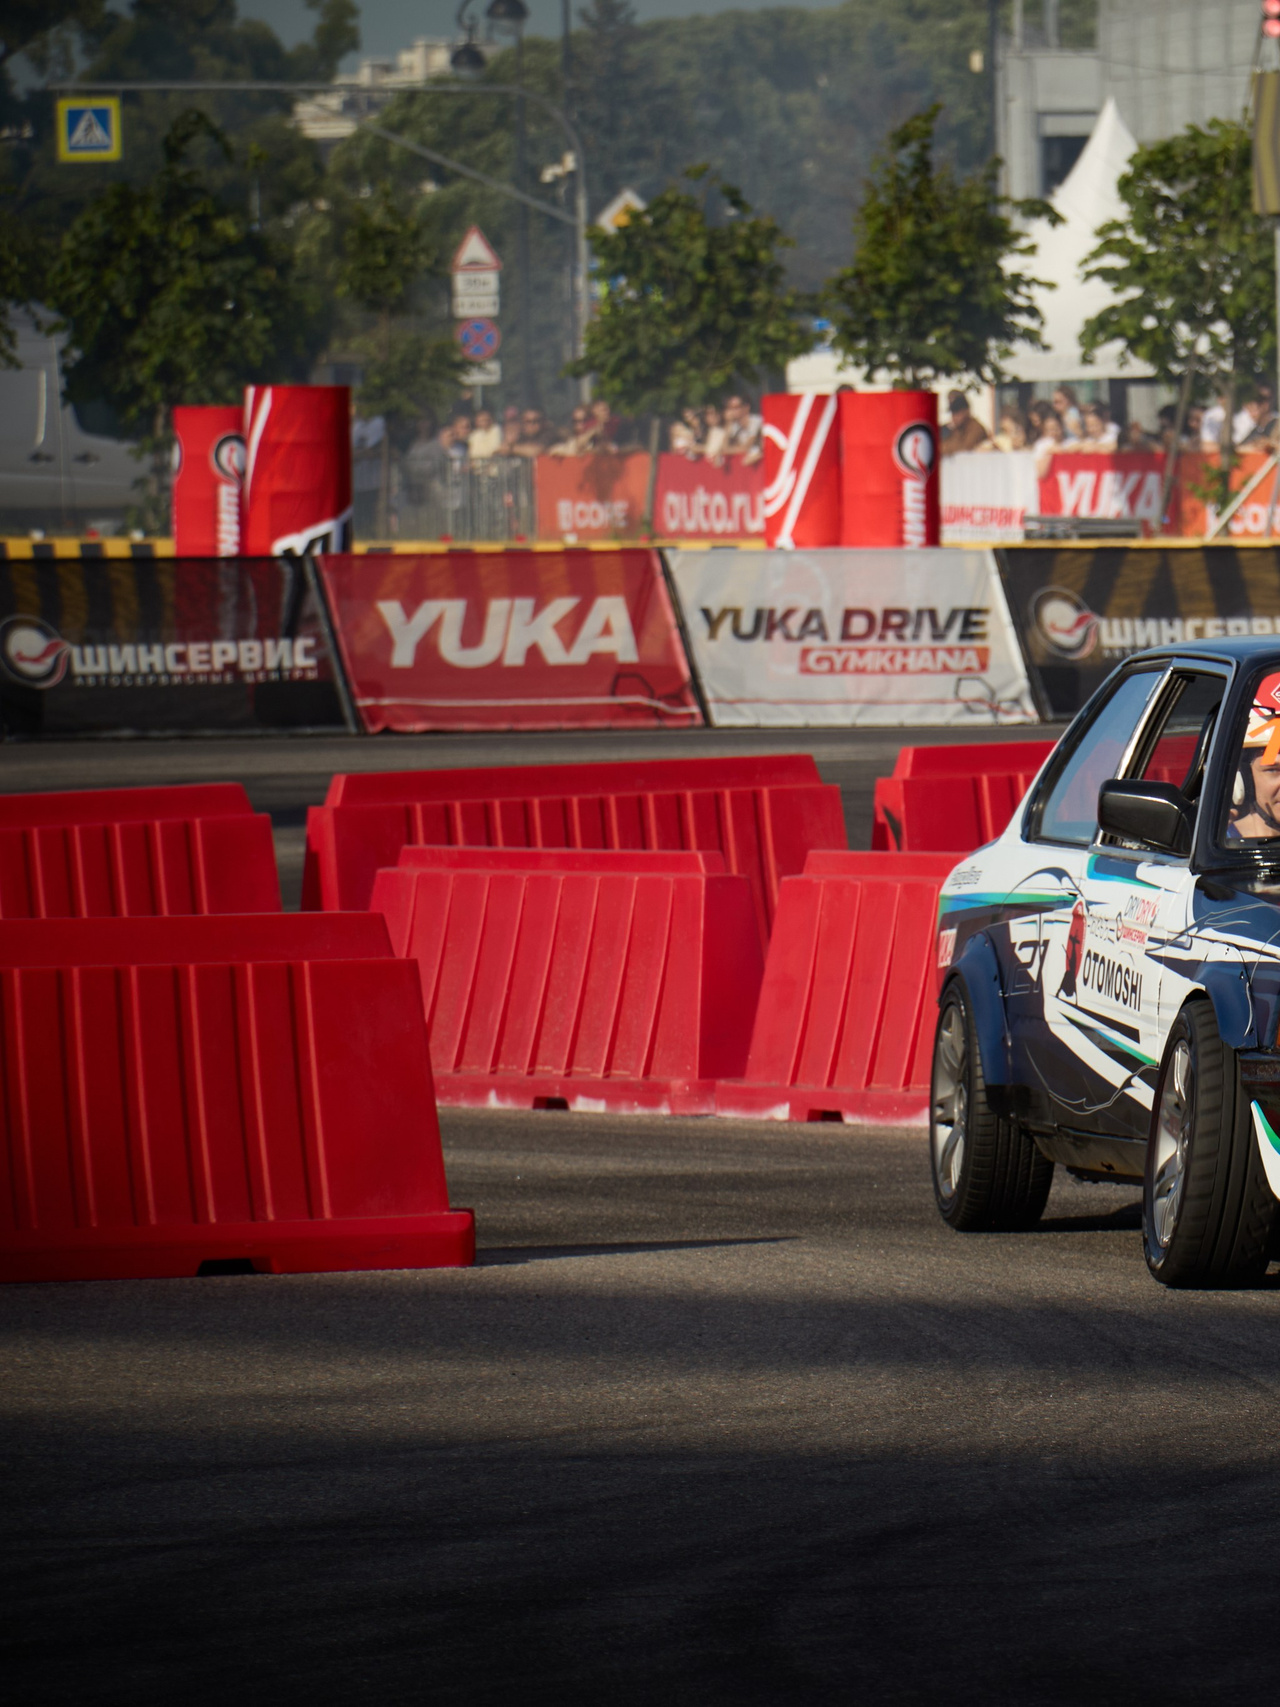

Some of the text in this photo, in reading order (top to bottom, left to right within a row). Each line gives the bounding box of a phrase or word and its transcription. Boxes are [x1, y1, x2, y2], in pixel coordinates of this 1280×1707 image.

[663, 486, 766, 533] auto.ru
[1058, 470, 1163, 519] YUKA
[376, 595, 640, 669] YUKA
[701, 608, 991, 641] YUKA DRIVE
[70, 637, 318, 674] ШИНСЕРВИС
[806, 648, 980, 673] GYMKHANA
[74, 668, 319, 688] АВТОСЕРВИСНЫЕ ЦЕНТРЫ
[1082, 949, 1143, 1012] OTOMOSHI
